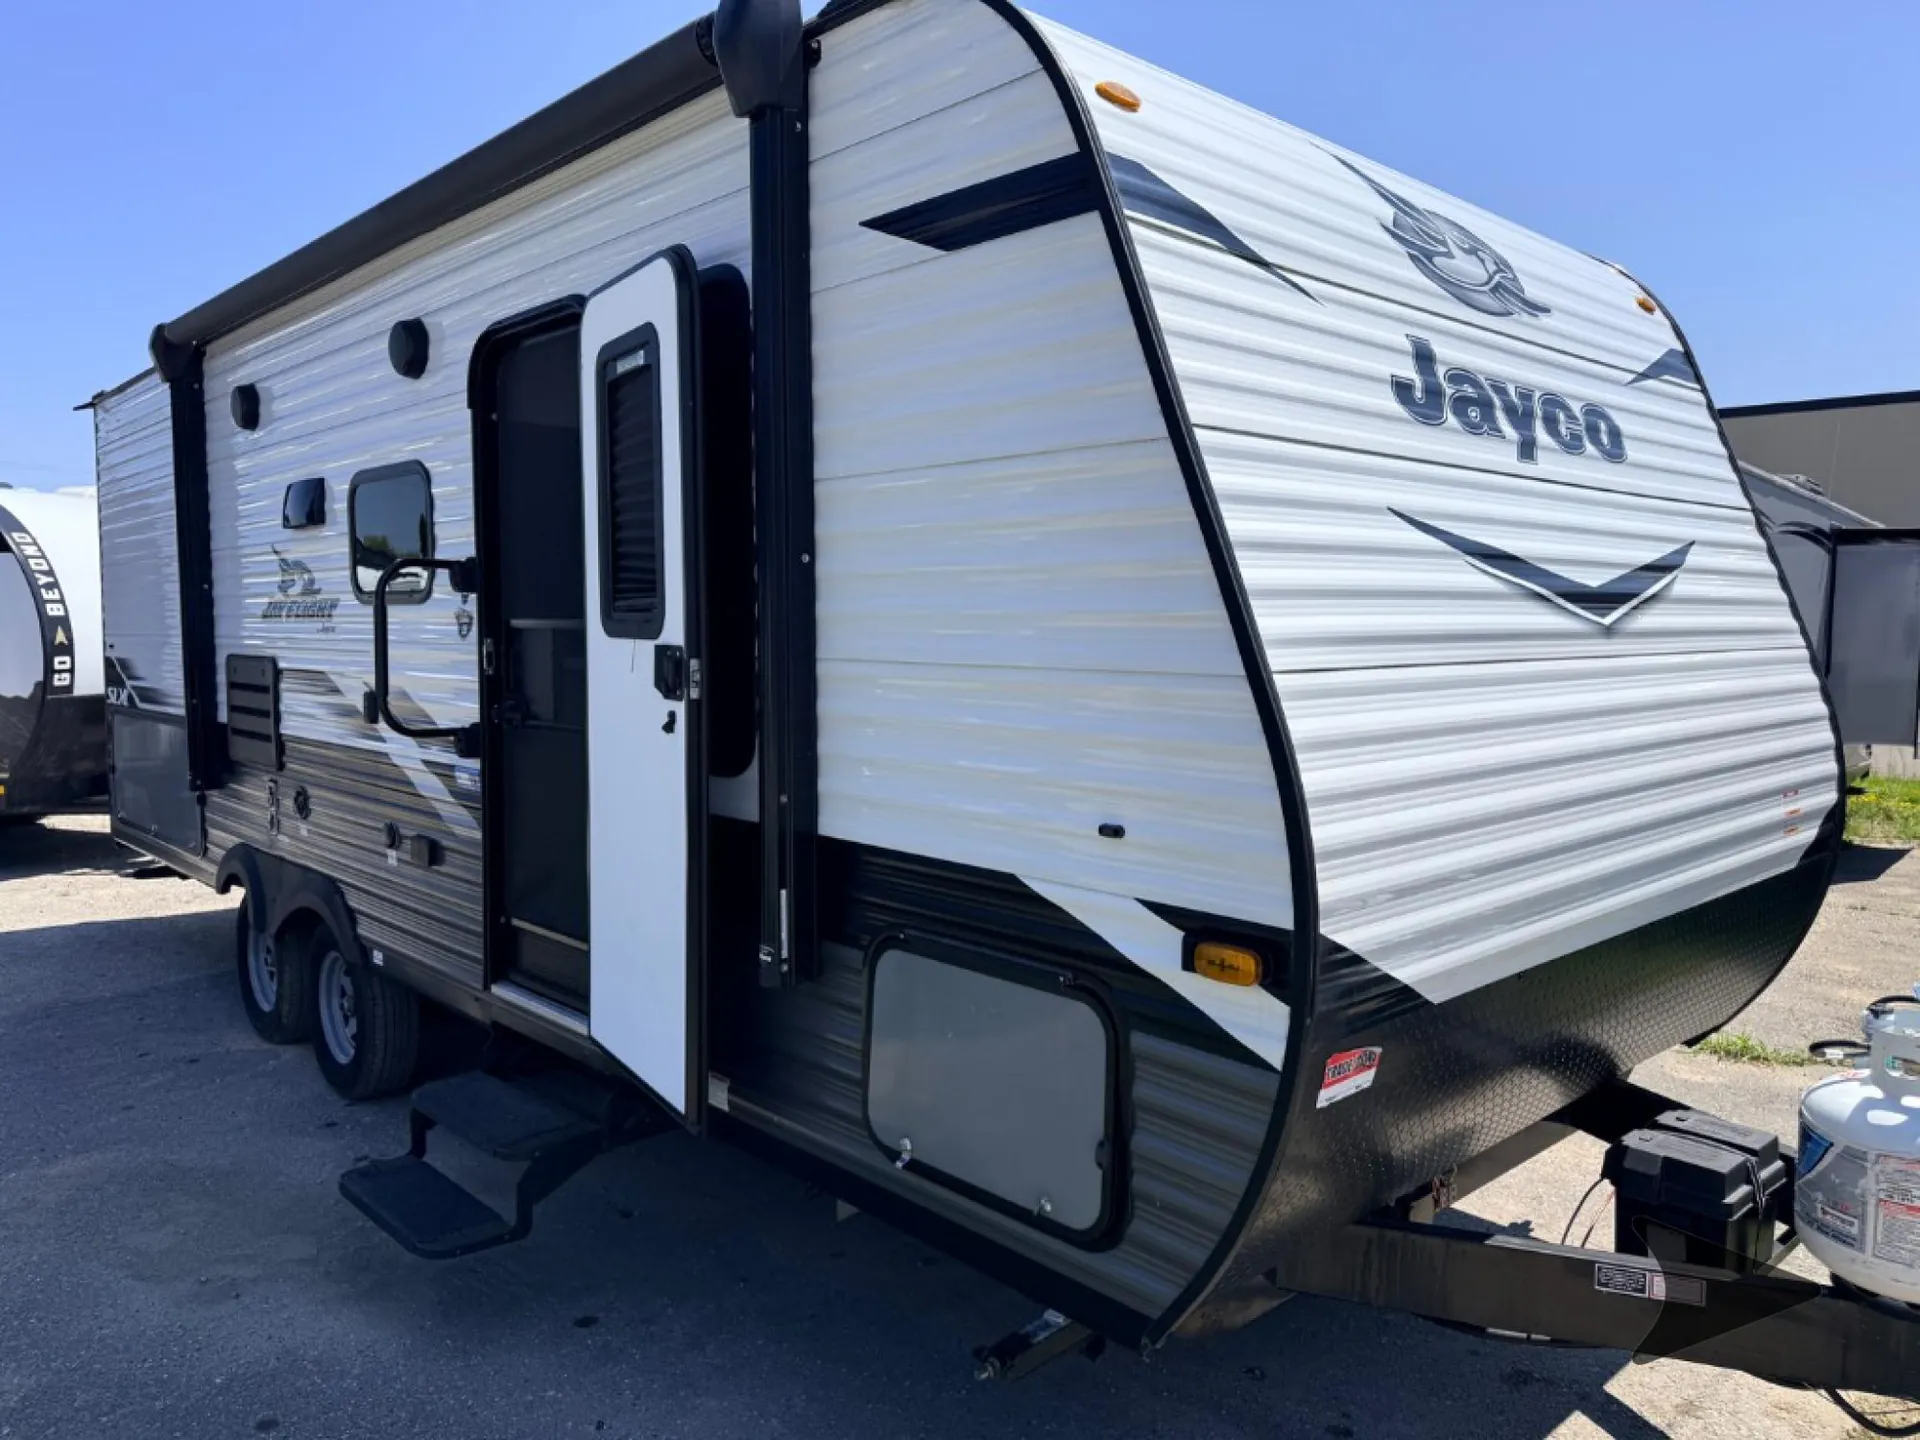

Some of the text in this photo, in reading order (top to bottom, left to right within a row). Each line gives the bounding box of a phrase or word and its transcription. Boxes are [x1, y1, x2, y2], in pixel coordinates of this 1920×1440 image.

[1391, 334, 1628, 465] Jayco
[11, 532, 71, 687] GO BEYOND
